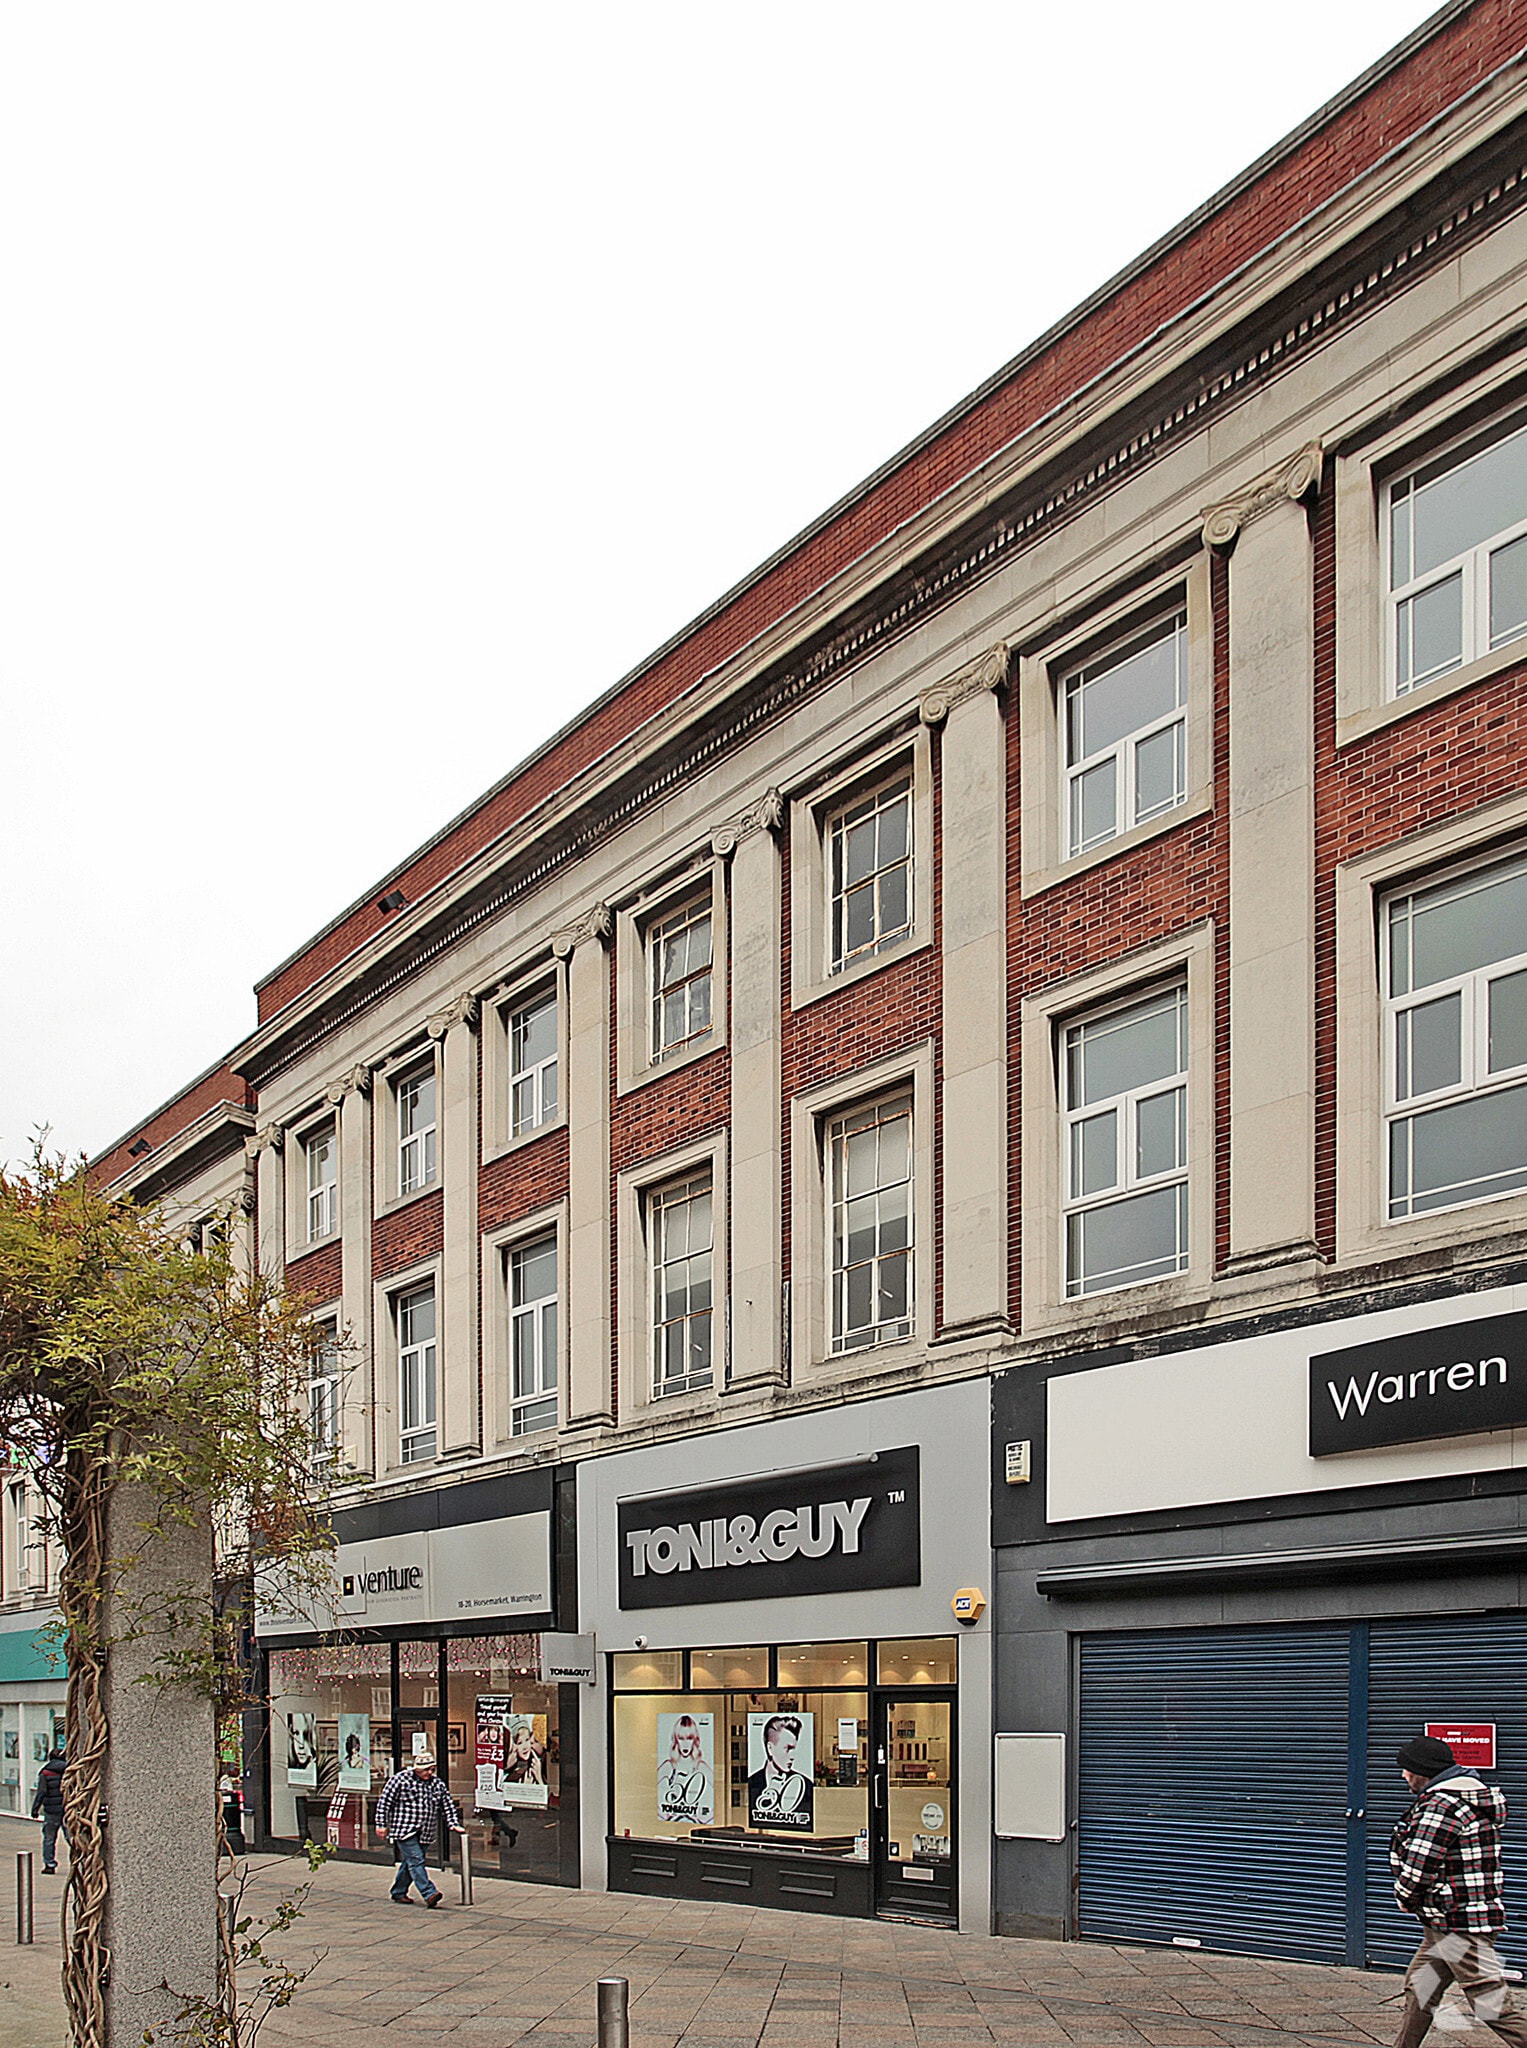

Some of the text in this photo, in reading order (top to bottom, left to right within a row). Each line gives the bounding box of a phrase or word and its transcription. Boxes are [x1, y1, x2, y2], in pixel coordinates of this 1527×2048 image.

[1327, 1356, 1508, 1421] Warren
[626, 1490, 905, 1577] TONI&GUY TM
[358, 1566, 422, 1594] venture
[510, 1593, 543, 1603] Warrington
[550, 1667, 592, 1677] TONI&GUY
[661, 1804, 698, 1815] TONI&GUY
[753, 1811, 796, 1822] TONI&GUY
